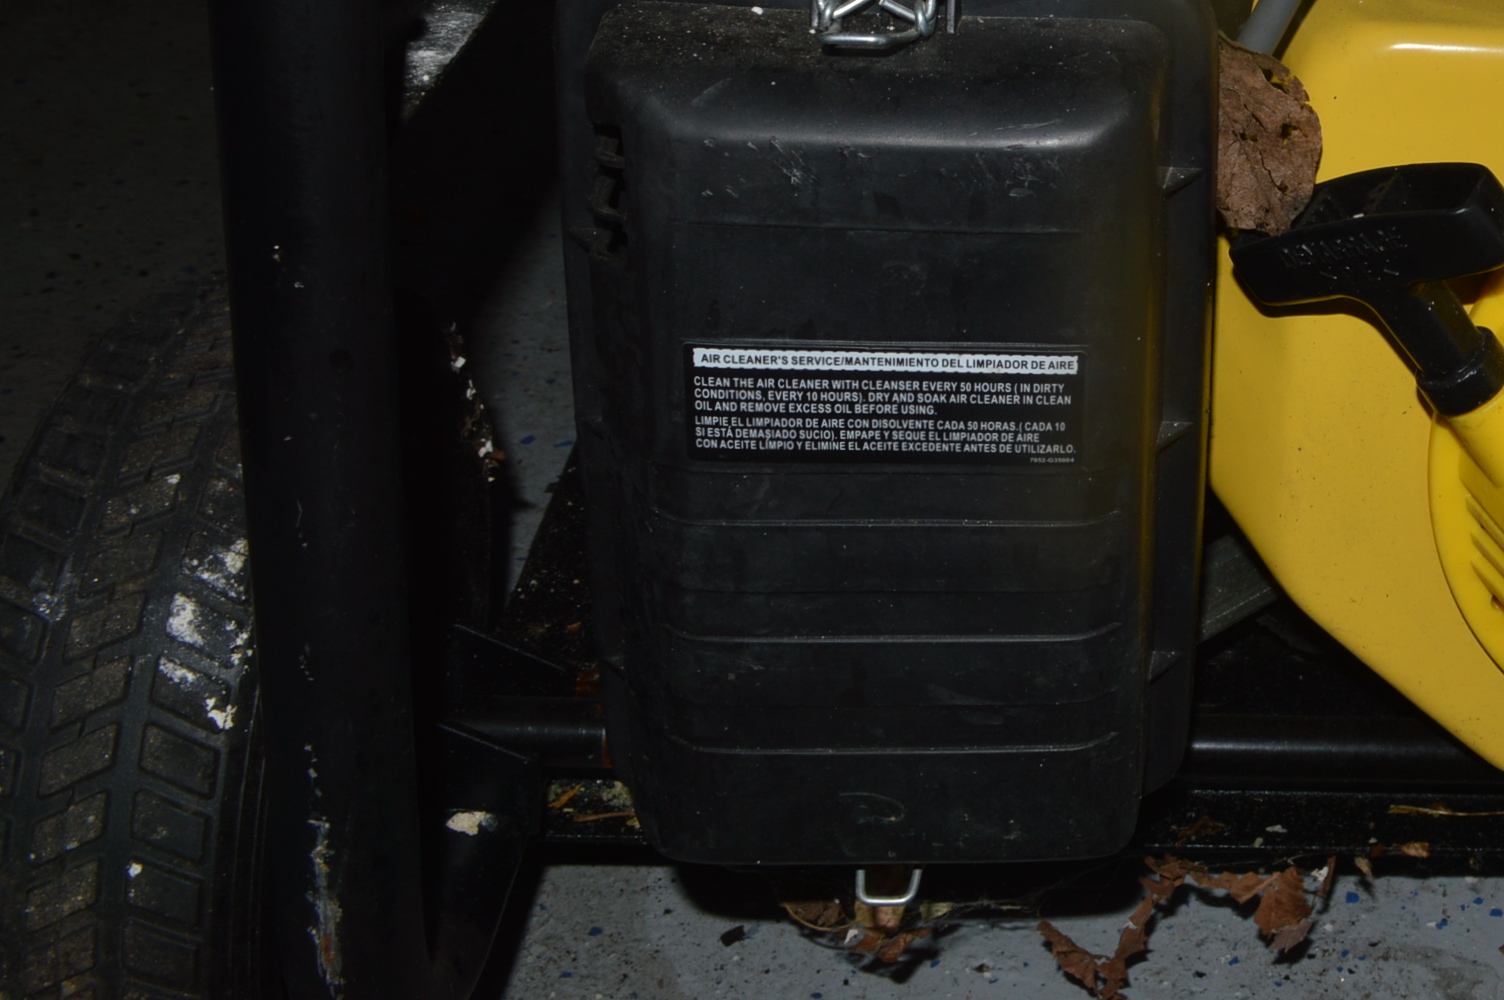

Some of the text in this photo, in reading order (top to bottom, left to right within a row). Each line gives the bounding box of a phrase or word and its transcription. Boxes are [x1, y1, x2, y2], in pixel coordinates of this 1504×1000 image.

[701, 354, 1075, 370] AIR CLEANER'S SERVICE/MANTENIMIENTO DEL LIMPIADOR DE AIRE
[694, 376, 730, 388] CLEAN
[733, 377, 755, 388] THE
[757, 378, 775, 389] AIR
[778, 379, 829, 390] CLEANER
[832, 380, 859, 390] WITH
[861, 380, 920, 391] CLEANSER
[922, 382, 957, 392] EVERY
[960, 382, 971, 392] 50
[974, 383, 1012, 393] HOURS
[1033, 384, 1064, 394] DIRTY
[694, 389, 1071, 405] CONDITIONS, EVERY 10 HOURS). DRY AND SOAK AIR CLEANER IN CLEAN
[695, 401, 937, 416] OIL AND REMOVE EXCESS OIL BEFORE USING.
[731, 417, 743, 427] EL
[746, 417, 803, 428] LIMPIADOR
[805, 418, 819, 428] DE
[821, 419, 845, 429] AIRE
[847, 419, 869, 429] CON
[872, 419, 935, 430] DISOLVENTE
[937, 421, 965, 430] CADA
[967, 421, 978, 431] 50
[1055, 422, 1065, 431] 10
[695, 427, 705, 437] SI
[735, 428, 797, 439] DEMASIADO
[799, 429, 837, 441] SUCIO).
[840, 430, 881, 440] EMPAPE
[883, 431, 889, 440] Y
[892, 431, 926, 441] SEQUE
[929, 431, 941, 441] EL
[943, 432, 999, 442] LIMPIADOR
[1001, 433, 1014, 442] DE
[1017, 433, 1040, 442] AIRE
[696, 439, 718, 449] CON
[720, 439, 757, 450] ACEITE
[796, 441, 803, 450] Y
[805, 441, 846, 451] ELIMINE
[848, 442, 860, 451] EL
[862, 442, 899, 452] ACEITE
[902, 442, 961, 453] EXCEDENTE
[964, 443, 997, 453] ANTES
[999, 444, 1012, 453] DE
[1015, 444, 1076, 454] UTILIZARLO.
